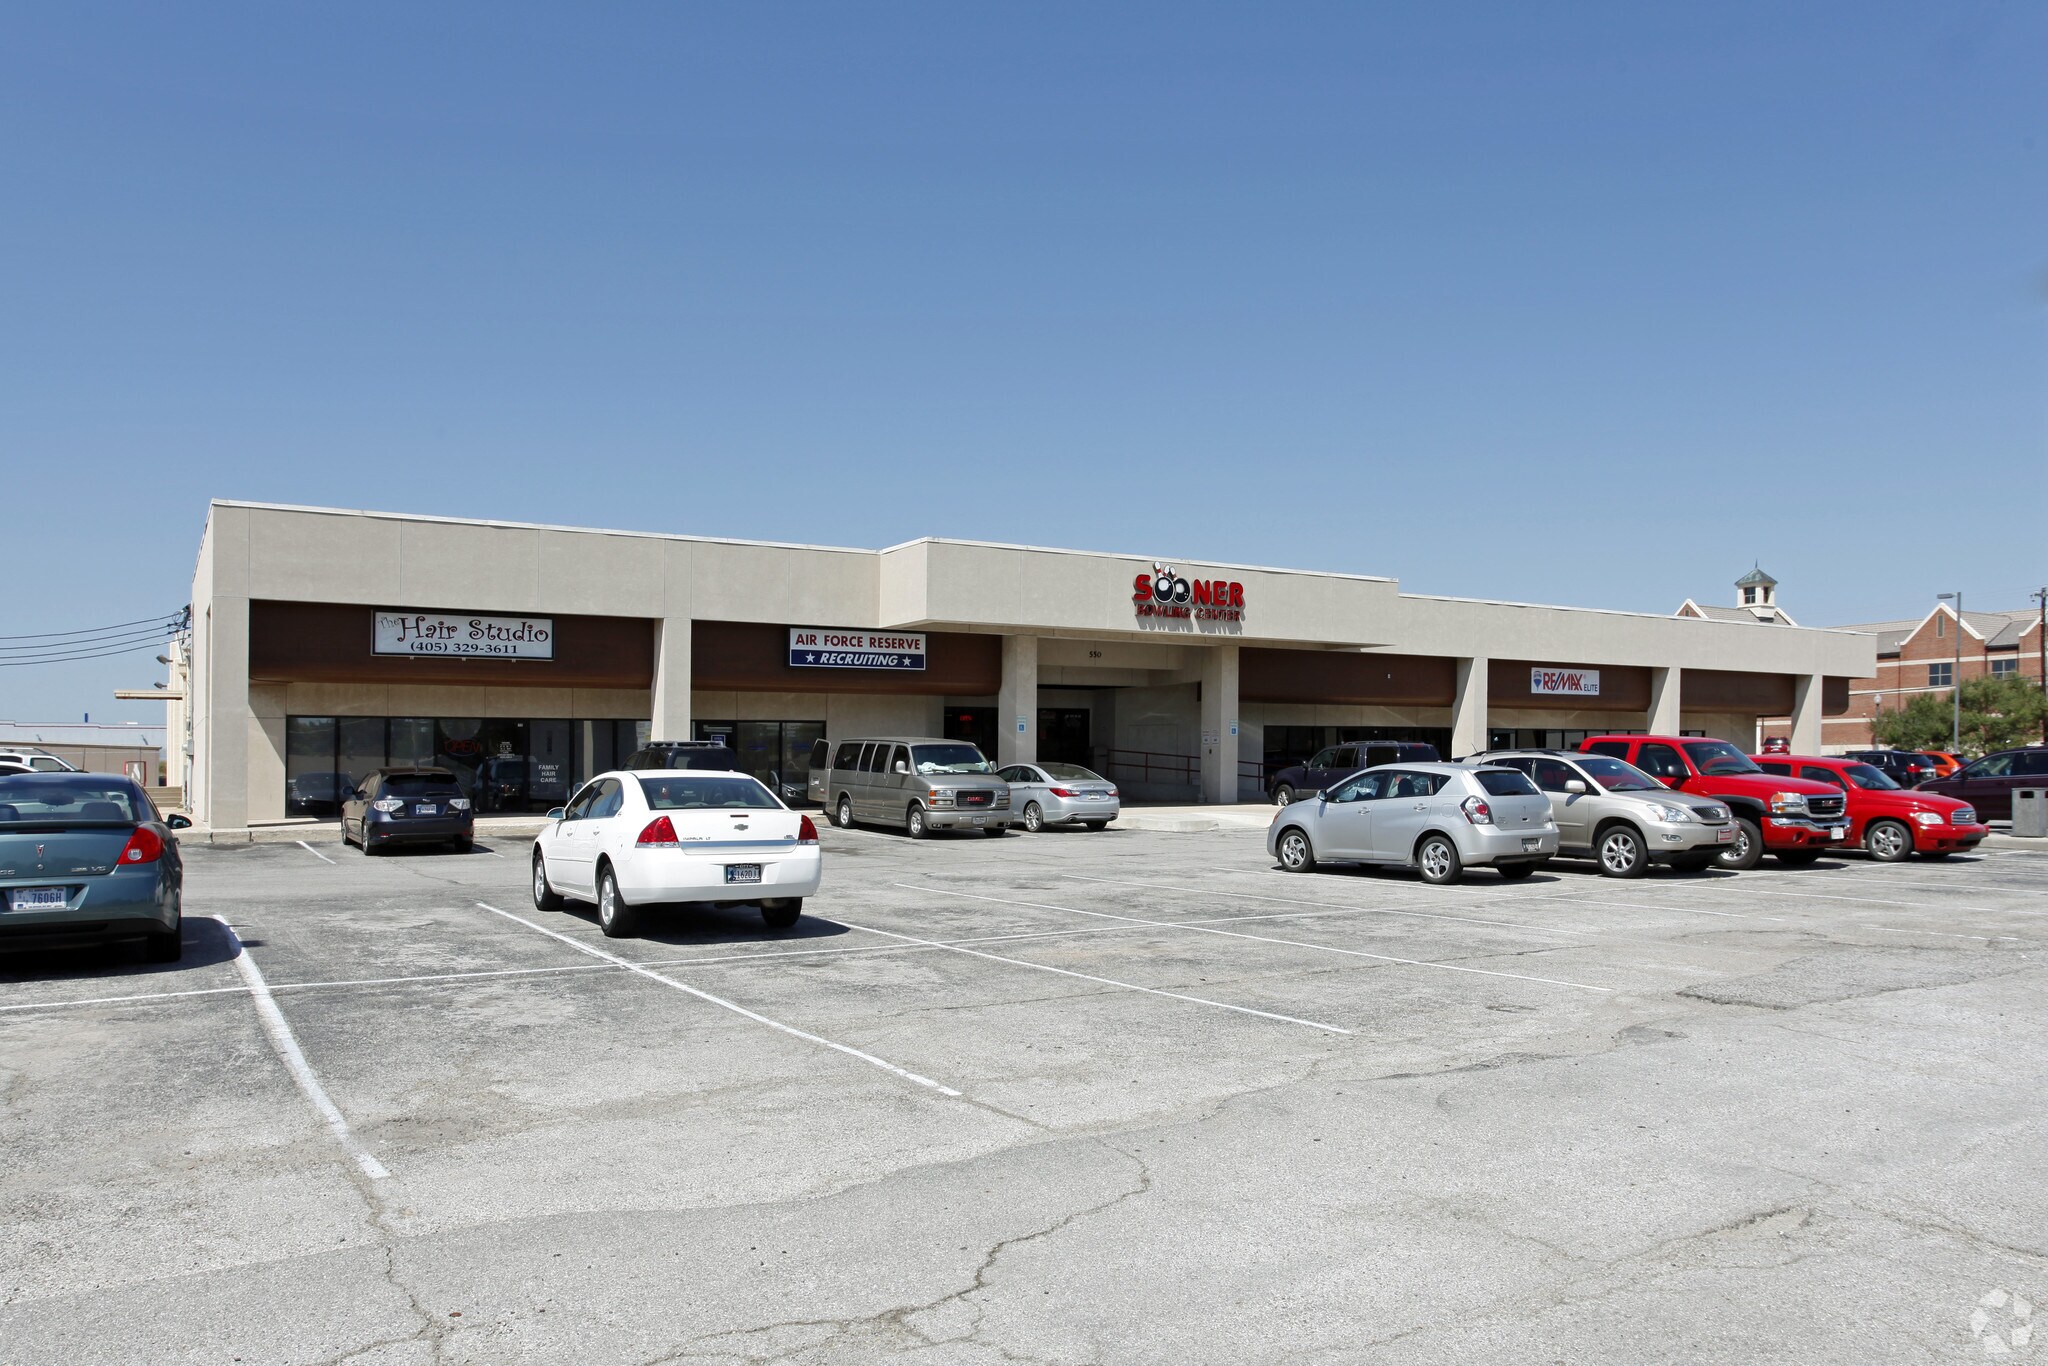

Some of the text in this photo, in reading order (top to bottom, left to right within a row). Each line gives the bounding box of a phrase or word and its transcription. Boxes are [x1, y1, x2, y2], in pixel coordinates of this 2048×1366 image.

[1134, 574, 1244, 607] SOONER
[1136, 604, 1241, 622] BOWLING CENTER
[377, 615, 550, 643] The Hair Studio
[410, 641, 519, 655] (405) 329-3611
[795, 633, 921, 650] AIR FORCE RESERVE
[819, 652, 899, 667] RECRUITING
[1089, 650, 1102, 658] 550
[1543, 672, 1583, 691] RE/MAX
[1584, 684, 1598, 692] ELITE
